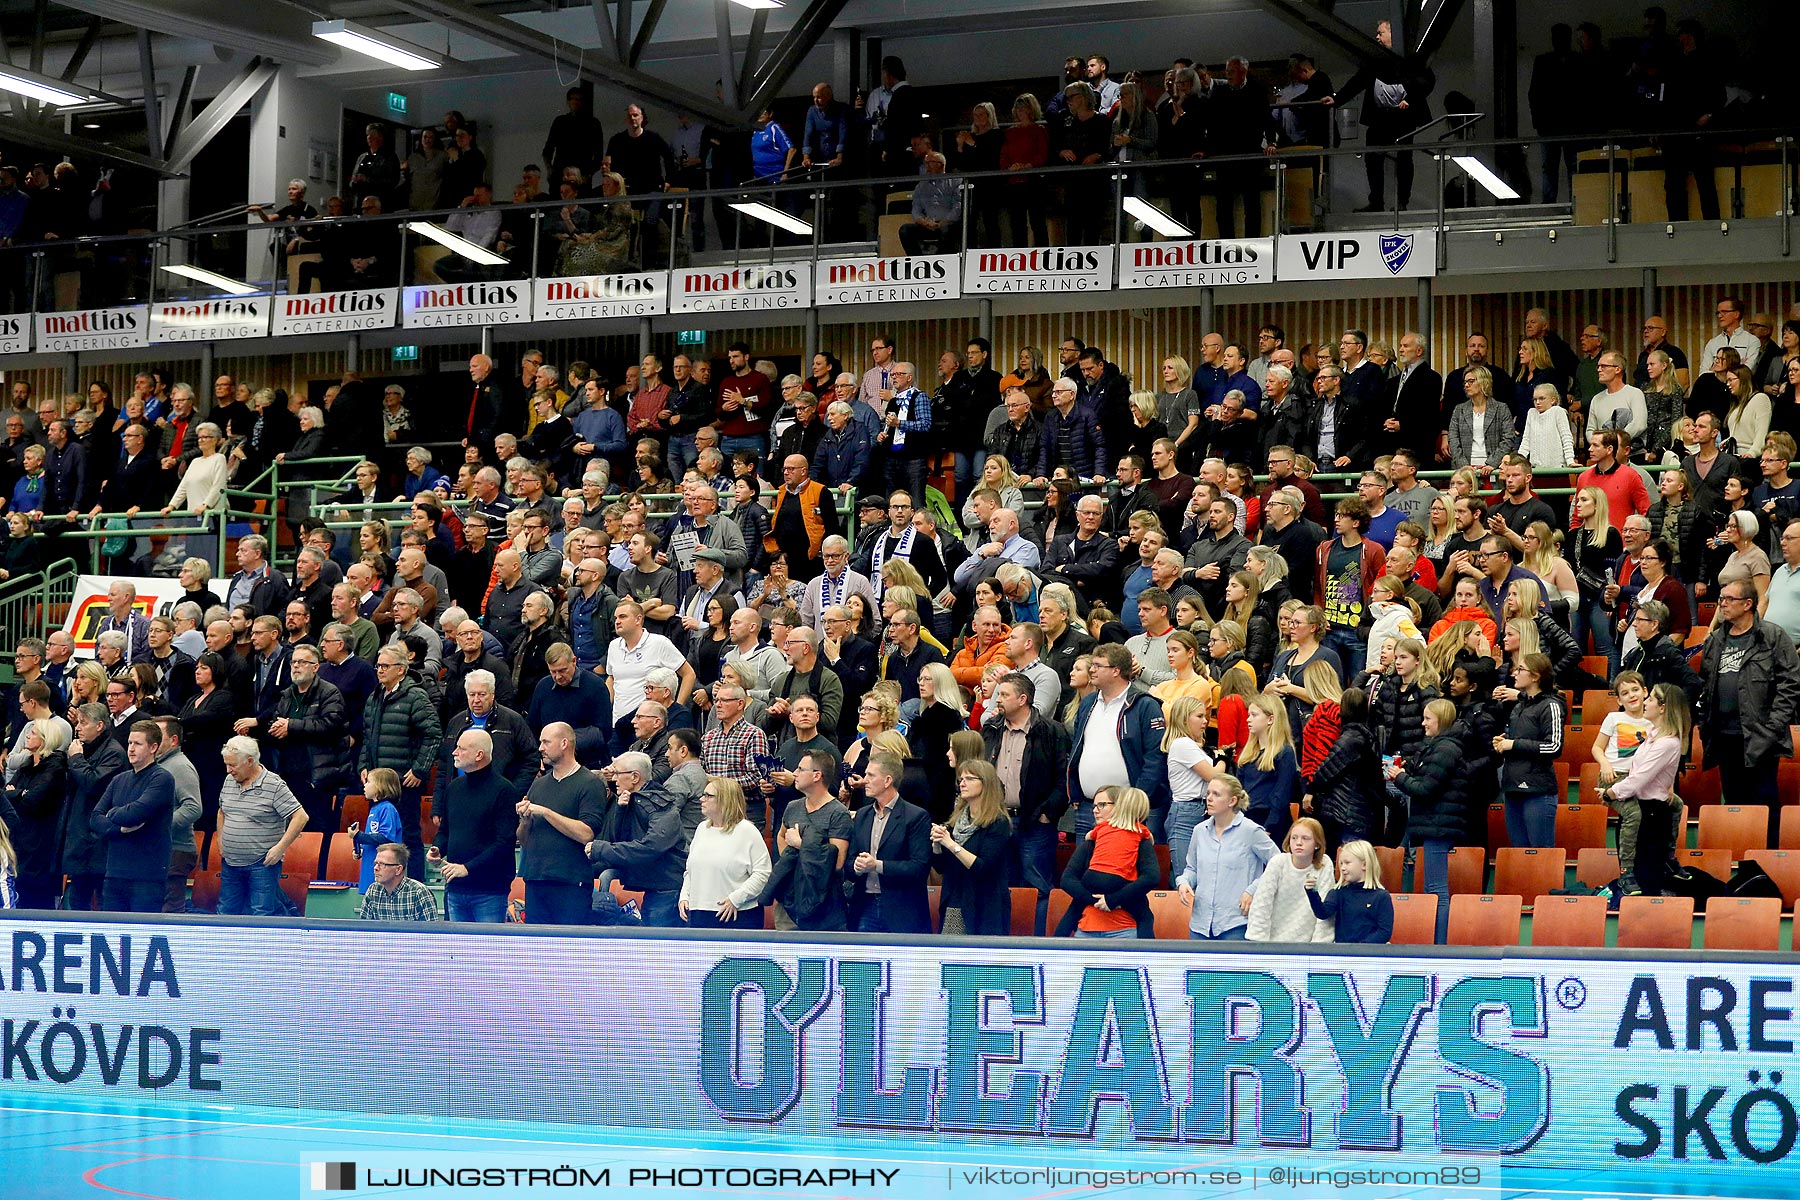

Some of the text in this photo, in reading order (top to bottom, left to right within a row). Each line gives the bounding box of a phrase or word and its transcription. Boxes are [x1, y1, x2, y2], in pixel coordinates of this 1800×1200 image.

[979, 248, 1098, 272] mattias
[1134, 241, 1259, 267] mattias
[1300, 240, 1360, 270] VIP
[685, 267, 797, 292] mattias
[829, 258, 946, 283] mattias
[1144, 271, 1247, 287] CATERING
[415, 283, 517, 308] mattias
[547, 275, 654, 300] mattias
[839, 287, 936, 303] CATERING
[988, 278, 1087, 292] CATERING
[163, 300, 257, 324] mattias
[286, 292, 385, 316] mattias
[555, 303, 644, 319] CATERING
[693, 296, 787, 312] CATERING
[45, 310, 137, 334] mattias
[293, 317, 375, 333] CATERING
[423, 311, 509, 327] CATERING
[54, 337, 129, 351] CATERING
[168, 326, 248, 340] CATERING
[0, 931, 181, 997] RENA
